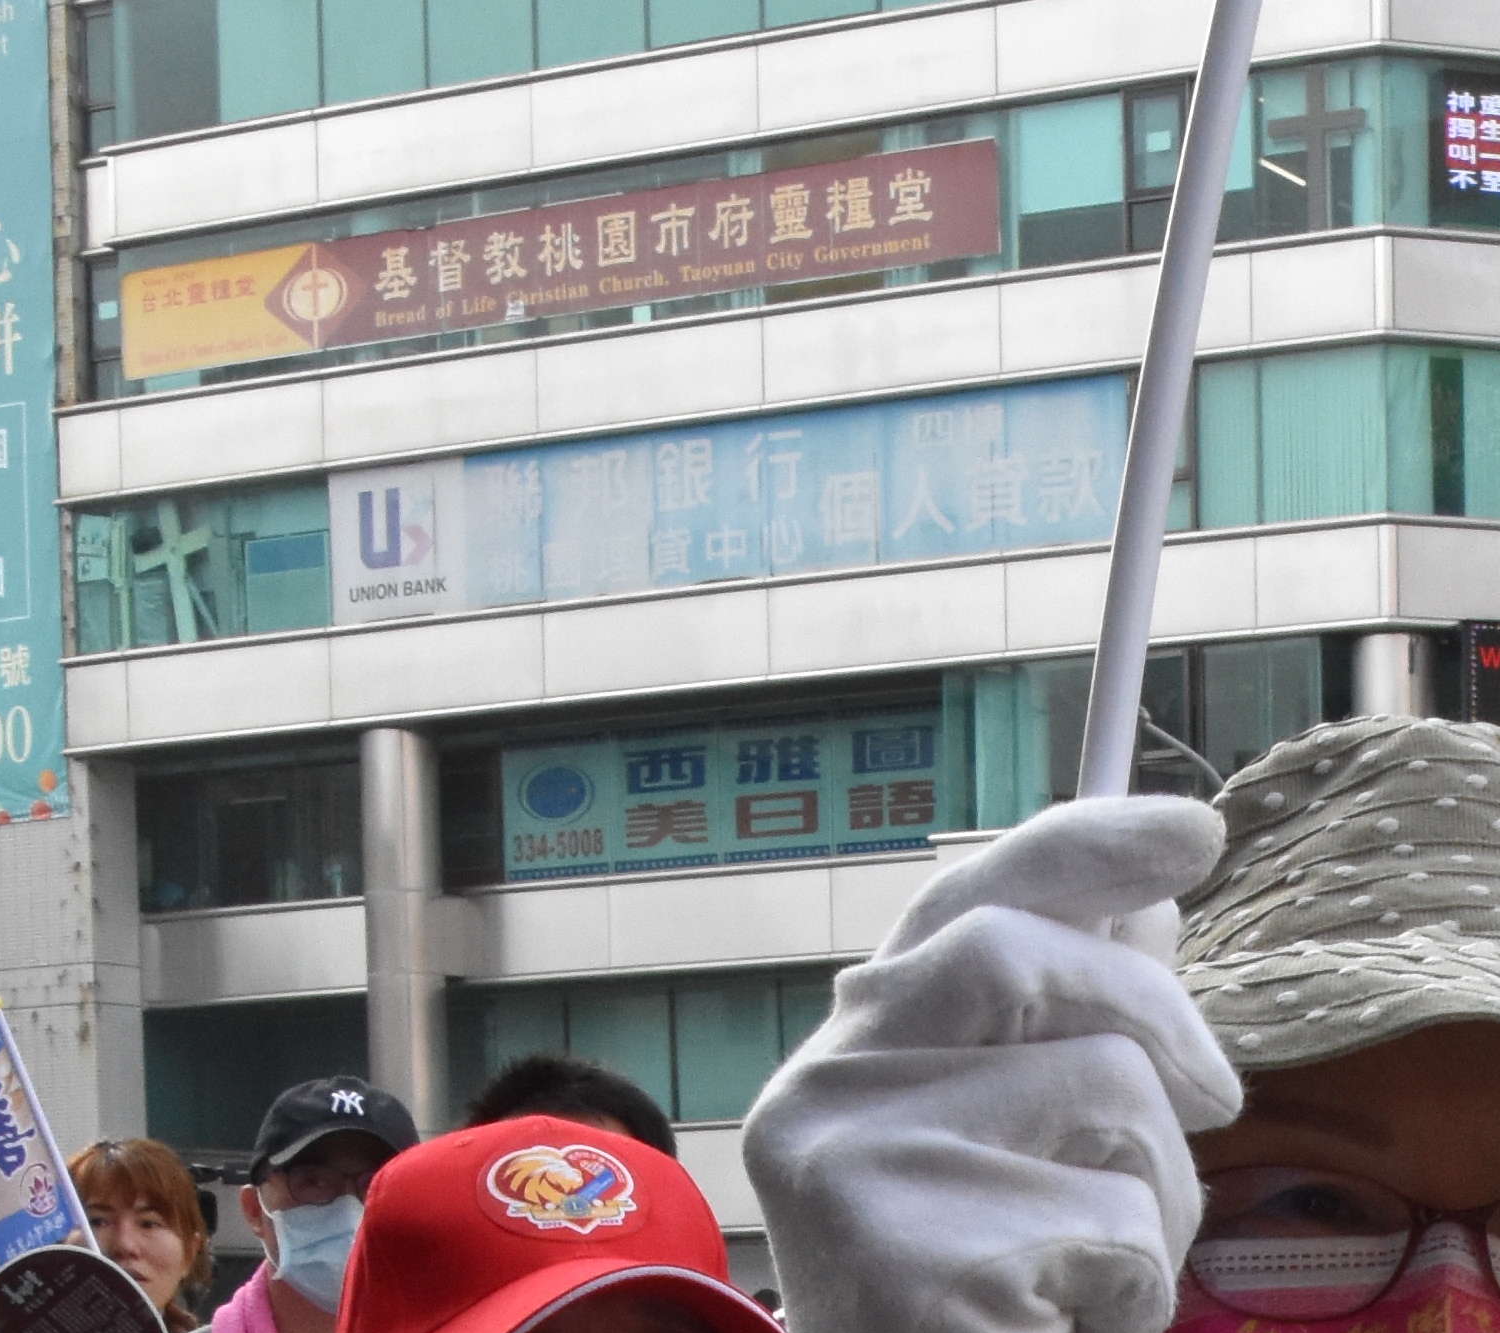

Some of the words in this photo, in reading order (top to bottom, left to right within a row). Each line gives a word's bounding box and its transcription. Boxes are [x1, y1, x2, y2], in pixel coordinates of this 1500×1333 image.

[374, 167, 935, 302] 基督教桃園市府靈糧堂
[375, 308, 427, 328] Bread
[435, 302, 456, 321] of
[461, 295, 498, 317] Life
[679, 257, 757, 283] Taoyuan
[765, 250, 804, 272] City
[814, 232, 934, 266] Government
[482, 428, 805, 530] 聯邦銀行
[817, 448, 1106, 546] 個人貸款
[348, 584, 399, 605] UNION
[402, 576, 449, 598] BANK
[622, 722, 937, 797] 西雅圖
[624, 777, 937, 851] 美日語
